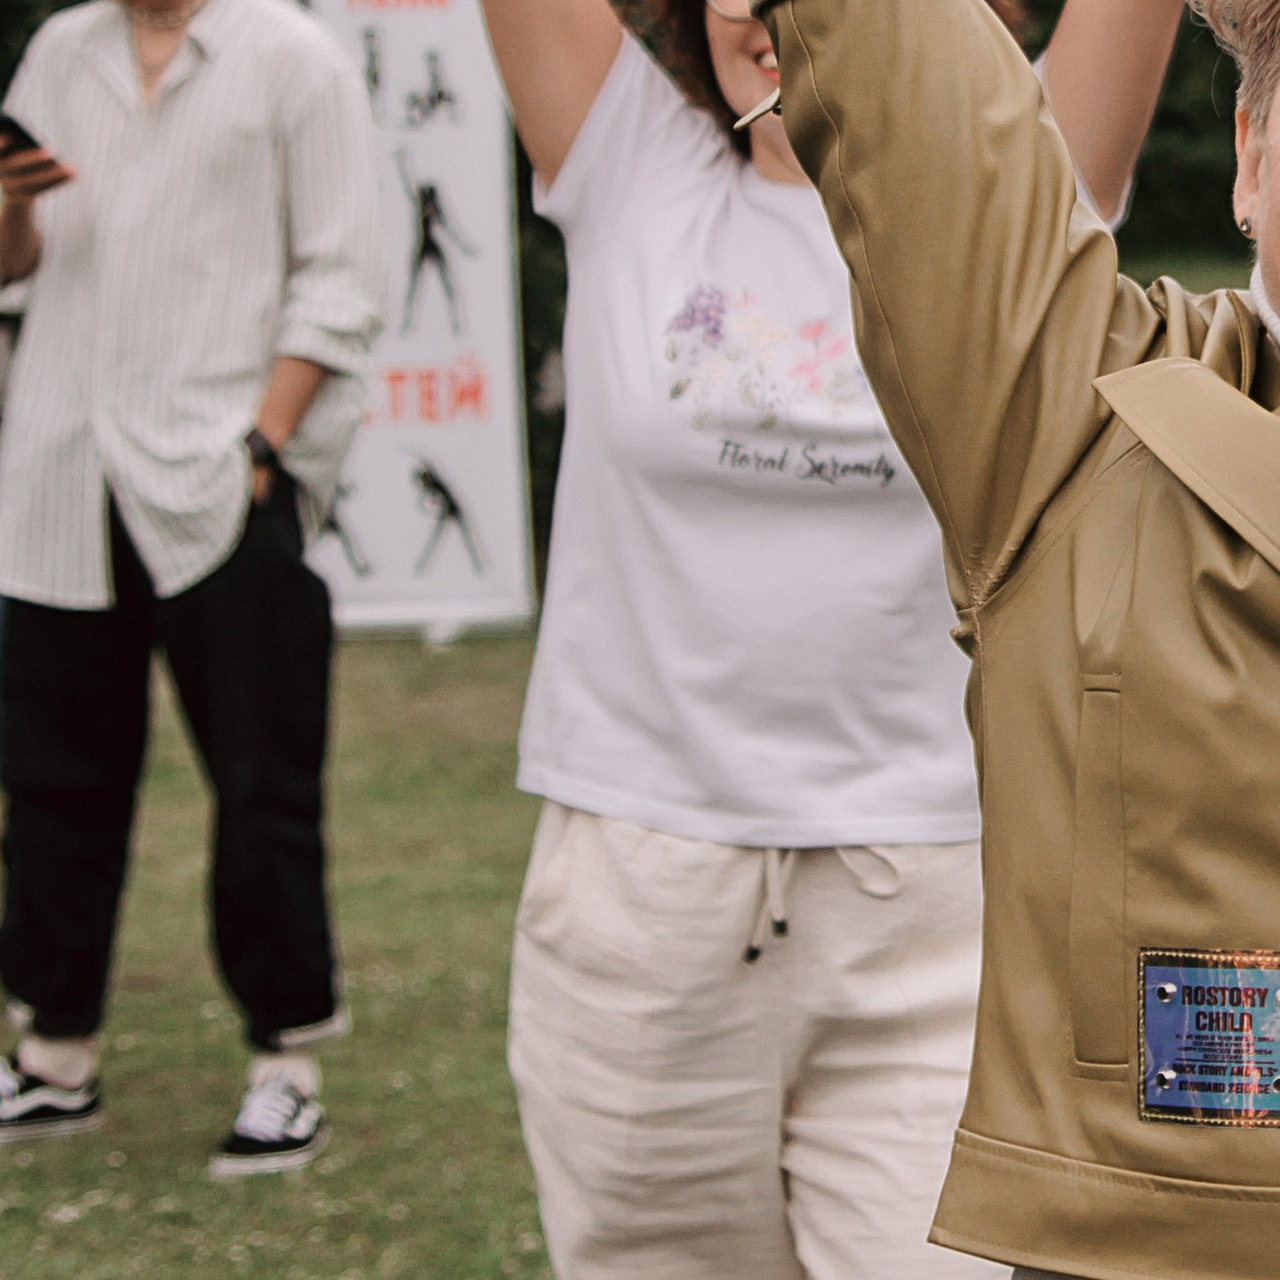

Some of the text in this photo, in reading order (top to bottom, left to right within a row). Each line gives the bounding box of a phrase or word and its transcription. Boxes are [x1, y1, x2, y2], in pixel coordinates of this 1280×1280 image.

[362, 347, 489, 424] ТЕЙ
[1181, 985, 1269, 1008] ROSTORY
[1195, 1010, 1253, 1033] CHILD
[1198, 1065, 1228, 1076] STORY
[1178, 1081, 1270, 1095] STANDARD SERVICE
